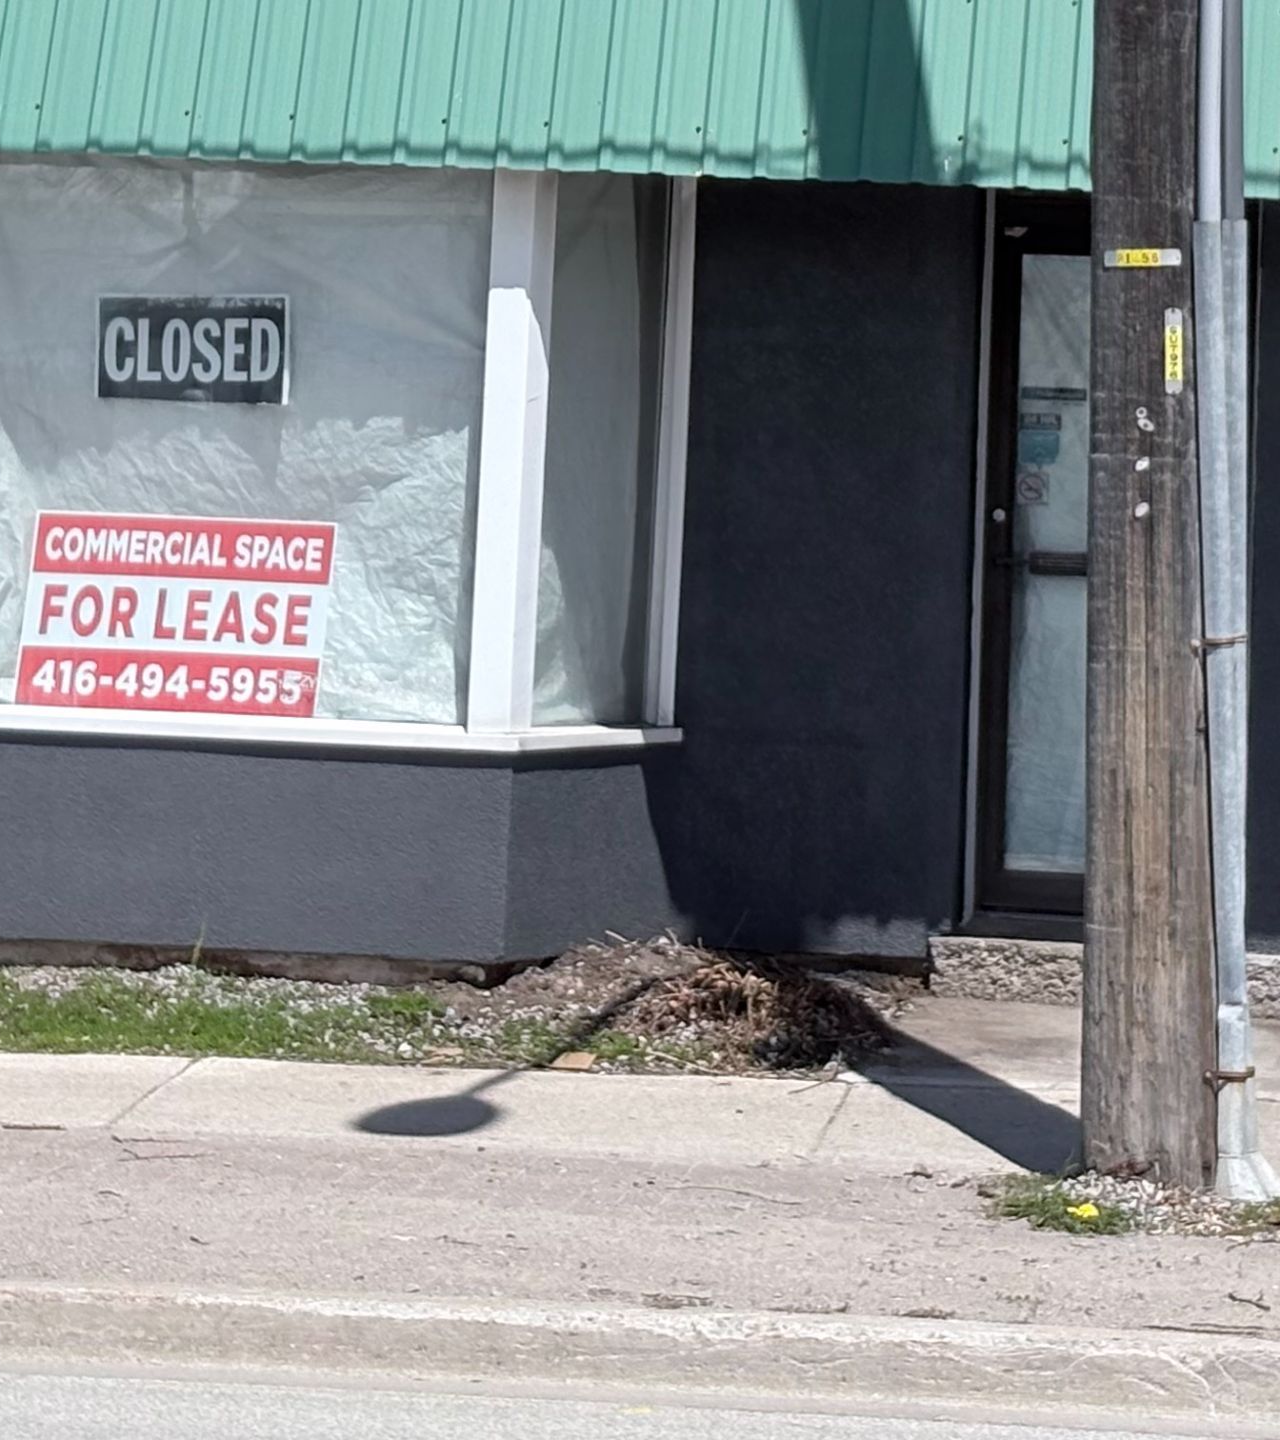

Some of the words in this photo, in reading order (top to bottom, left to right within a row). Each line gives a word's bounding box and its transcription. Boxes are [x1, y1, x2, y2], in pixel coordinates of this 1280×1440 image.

[103, 316, 281, 383] CLOSED
[44, 525, 227, 567] COMMERCIAL
[233, 534, 325, 572] SPACE
[38, 583, 139, 638] FOR
[153, 587, 313, 647] LEASE
[31, 658, 303, 705] 416-494-5955
